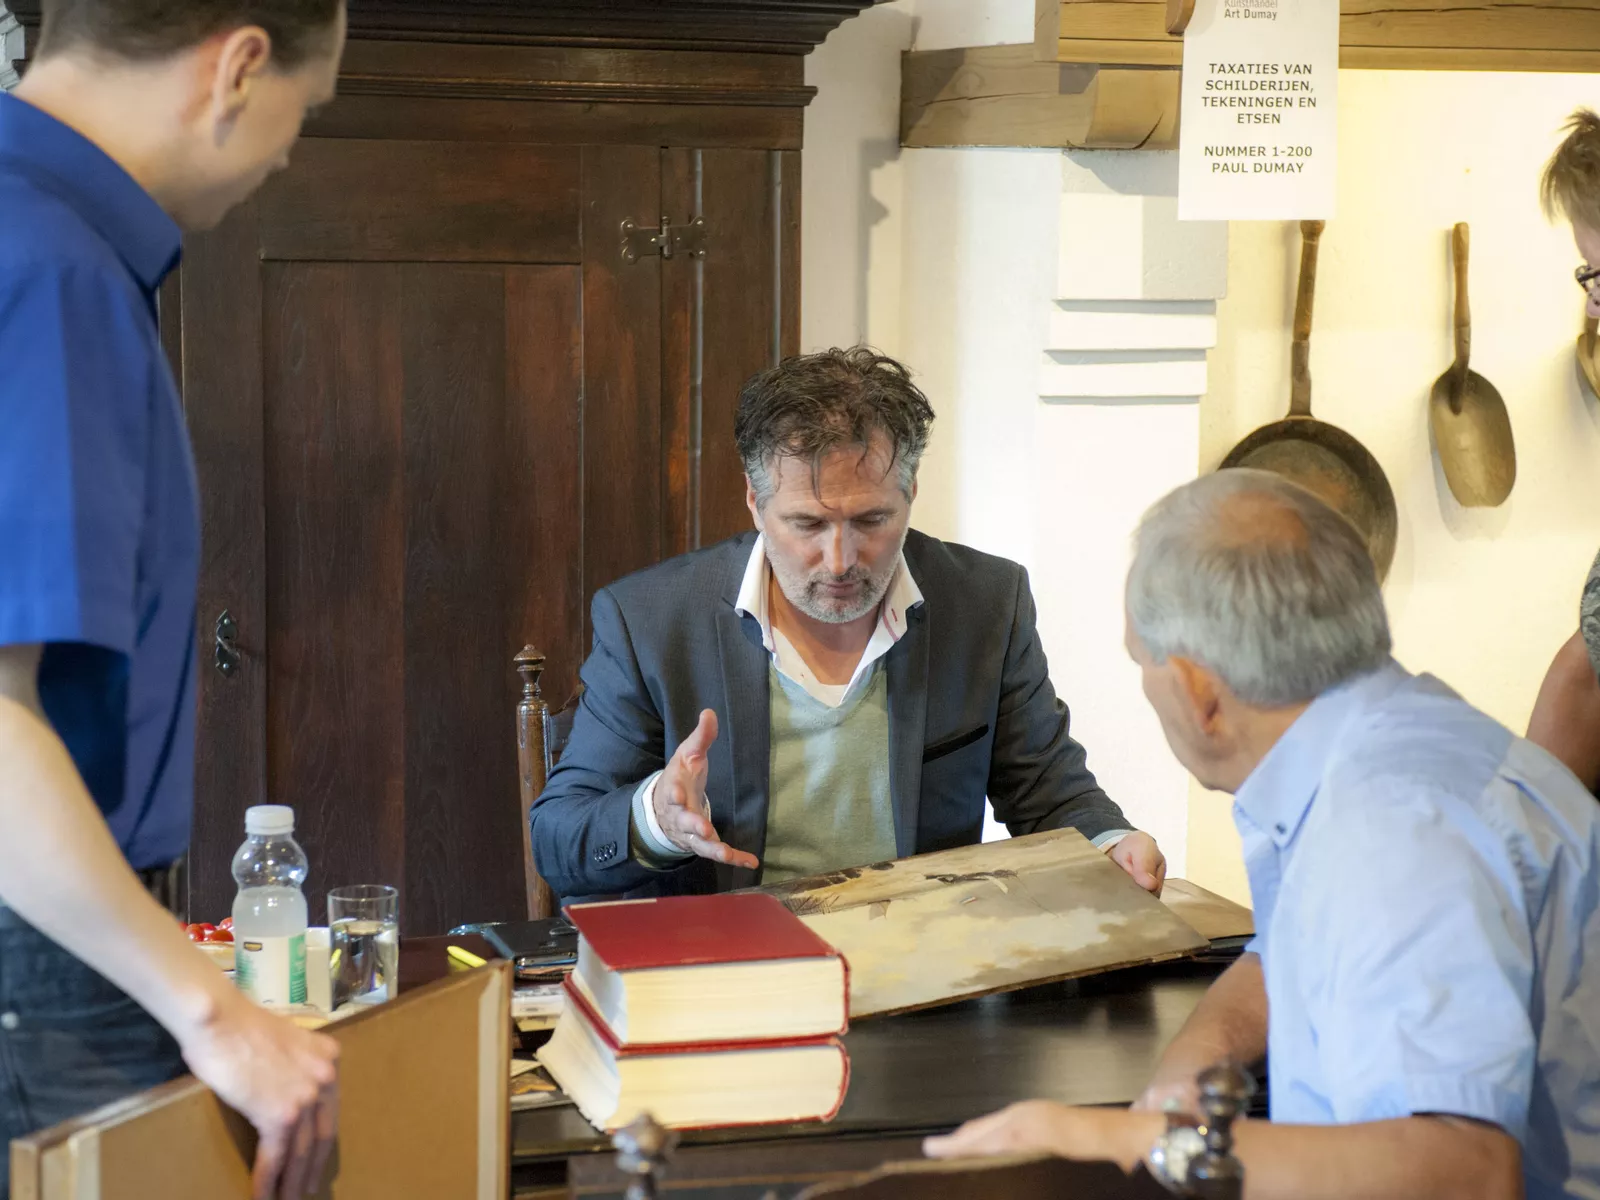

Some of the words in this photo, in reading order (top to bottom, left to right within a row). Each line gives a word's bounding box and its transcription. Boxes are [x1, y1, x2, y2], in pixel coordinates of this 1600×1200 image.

[1224, 9, 1240, 19] Art
[1244, 9, 1278, 20] Dumay
[1209, 63, 1279, 75] TAXATIES
[1283, 64, 1313, 75] VAN
[1205, 80, 1314, 94] SCHILDERIJEN,
[1202, 96, 1293, 108] TEKENINGEN
[1299, 97, 1317, 108] EN
[1237, 113, 1281, 124] ETSEN
[1204, 146, 1266, 157] NUMMER
[1272, 146, 1313, 157] 1-200
[1212, 163, 1248, 173] PAUL
[1253, 163, 1304, 173] DUMAY
